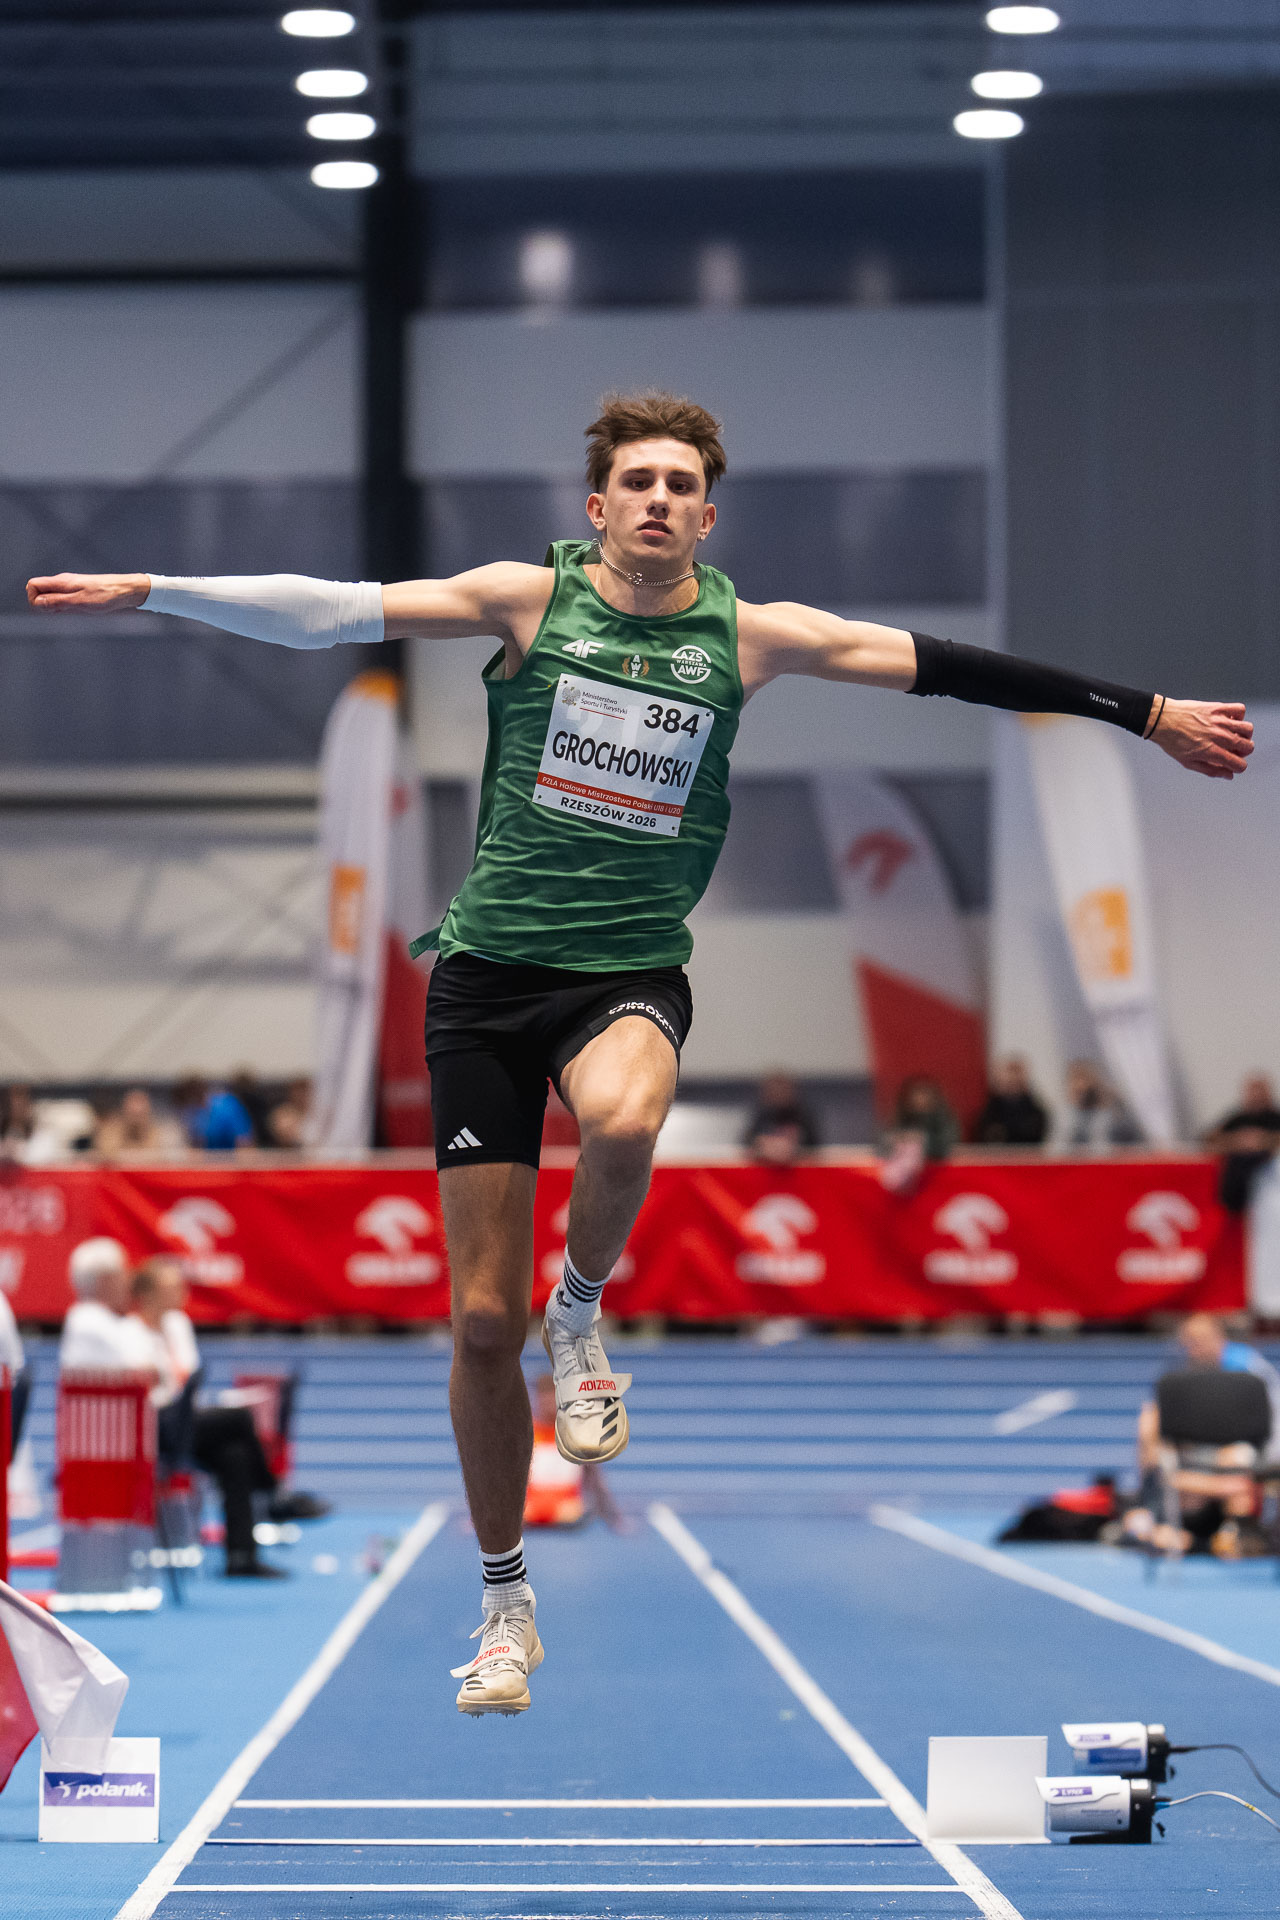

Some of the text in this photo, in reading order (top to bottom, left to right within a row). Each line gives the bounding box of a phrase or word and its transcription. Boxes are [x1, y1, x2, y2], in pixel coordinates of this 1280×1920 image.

[562, 639, 604, 659] 4F
[680, 651, 703, 662] AZS
[630, 654, 642, 678] AWF
[676, 659, 707, 668] WARSZAWA
[677, 665, 705, 677] AWF
[580, 698, 599, 708] Sportu
[603, 703, 628, 715] Turystyki
[582, 691, 618, 705] Ministerstwo
[644, 703, 700, 739] 384
[552, 730, 693, 789] GROCHOWSKI
[542, 776, 558, 787] PZLA
[559, 781, 587, 794] Halowe
[587, 789, 632, 805] Mistrzostwa
[632, 800, 653, 811] Polski
[653, 804, 664, 812] U18
[560, 796, 657, 828] RZESZÓW 2026
[578, 1380, 617, 1392] ADIZERO
[76, 1781, 148, 1800] polanik
